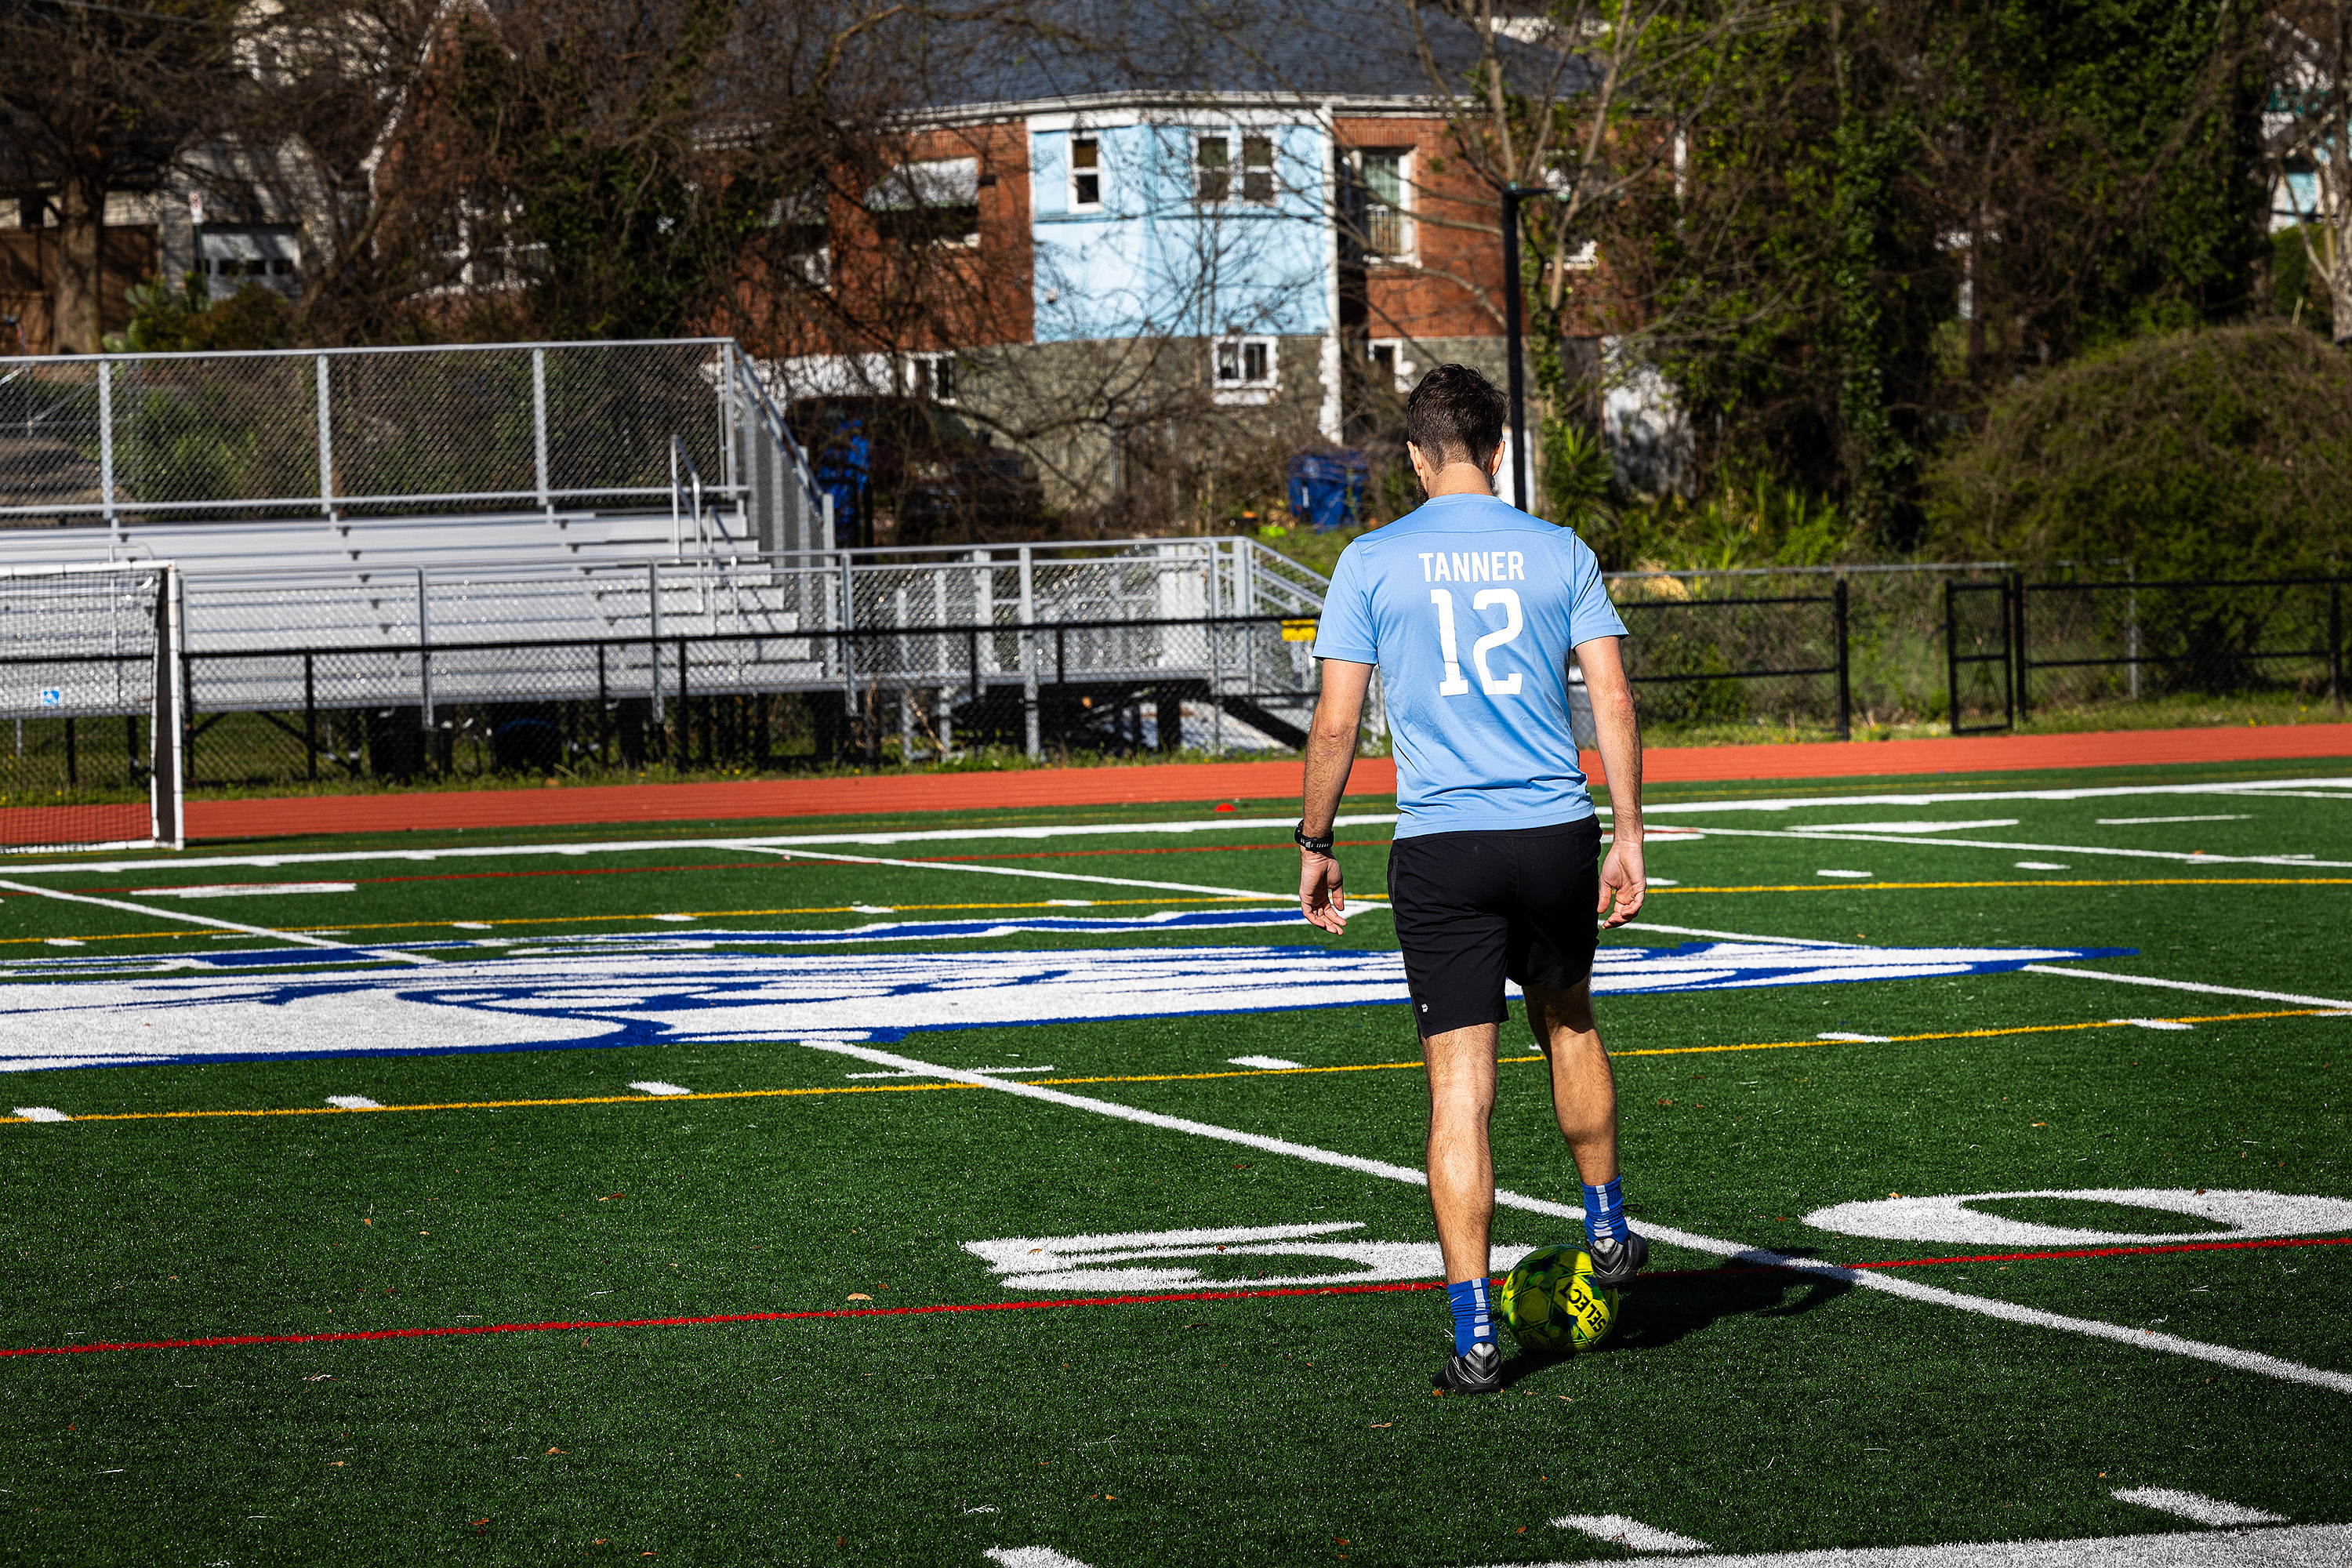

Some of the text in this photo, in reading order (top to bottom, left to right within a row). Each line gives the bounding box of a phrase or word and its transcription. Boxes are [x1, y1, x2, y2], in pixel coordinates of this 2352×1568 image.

[1418, 551, 1525, 583] TANNER
[1431, 588, 1523, 696] 12
[1559, 1281, 1607, 1333] SELECT
